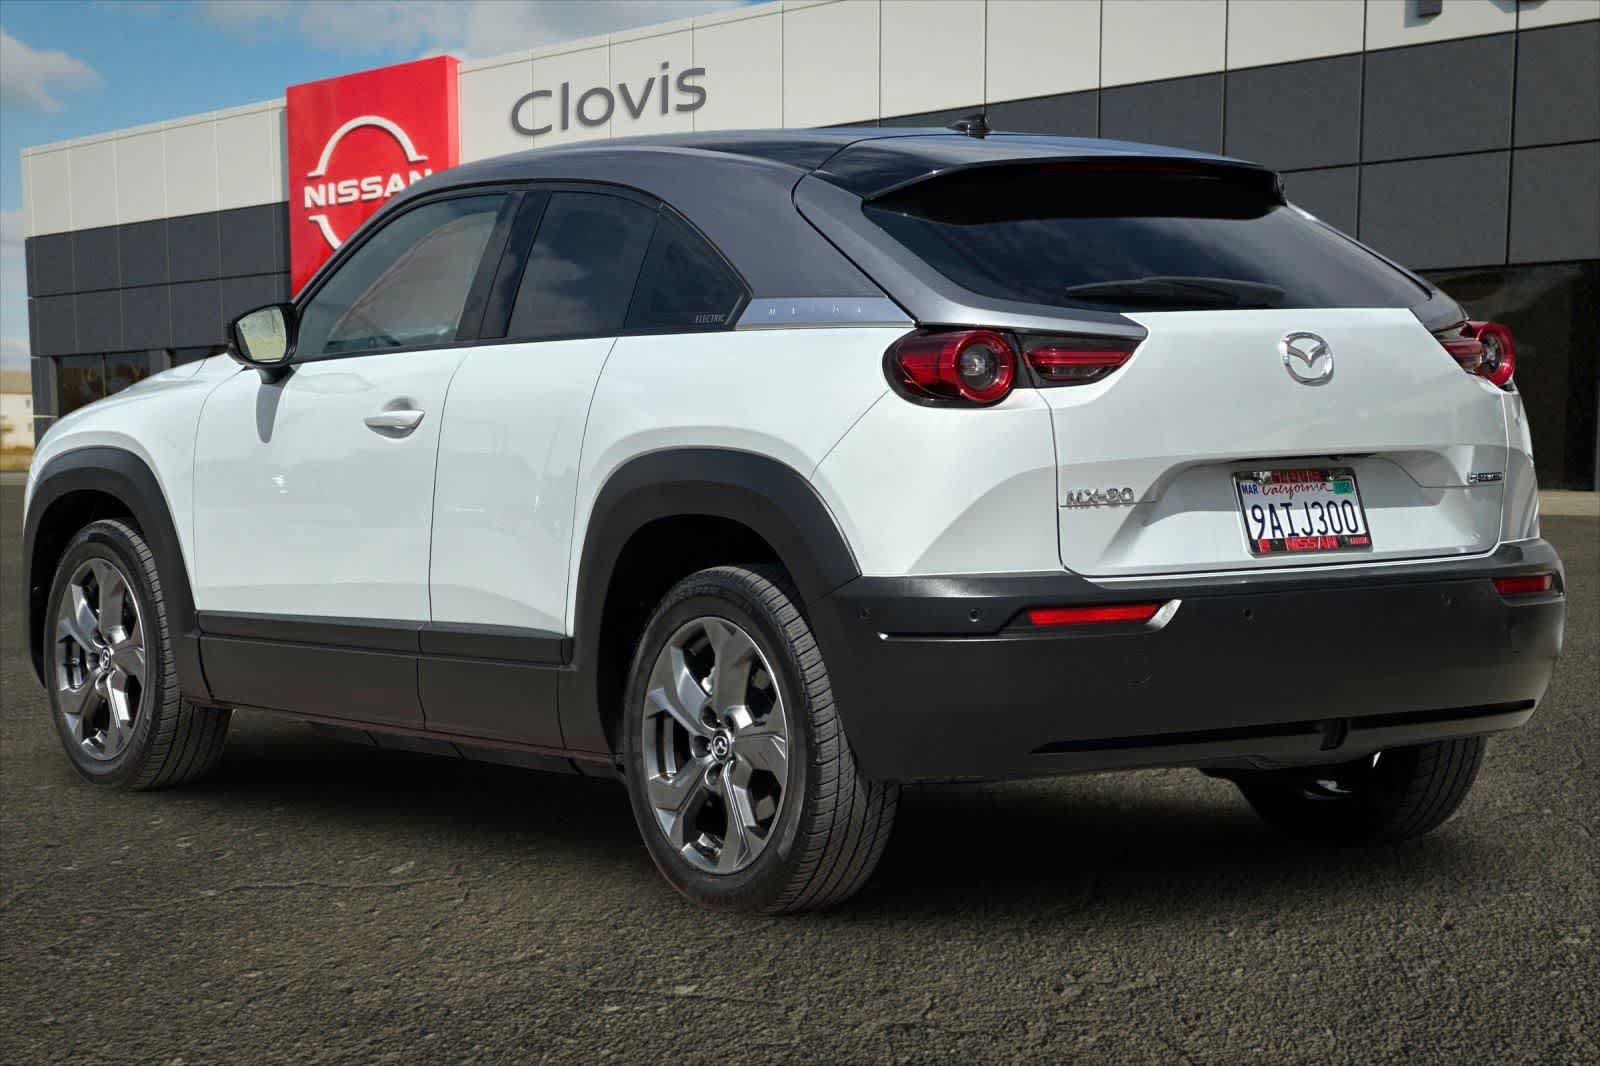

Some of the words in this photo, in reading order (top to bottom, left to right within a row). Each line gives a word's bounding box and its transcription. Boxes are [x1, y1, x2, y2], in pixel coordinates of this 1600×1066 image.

[511, 61, 708, 136] Clovis
[1241, 484, 1259, 495] MAR
[1261, 482, 1334, 499] California
[1251, 500, 1359, 540] 9AIJ300
